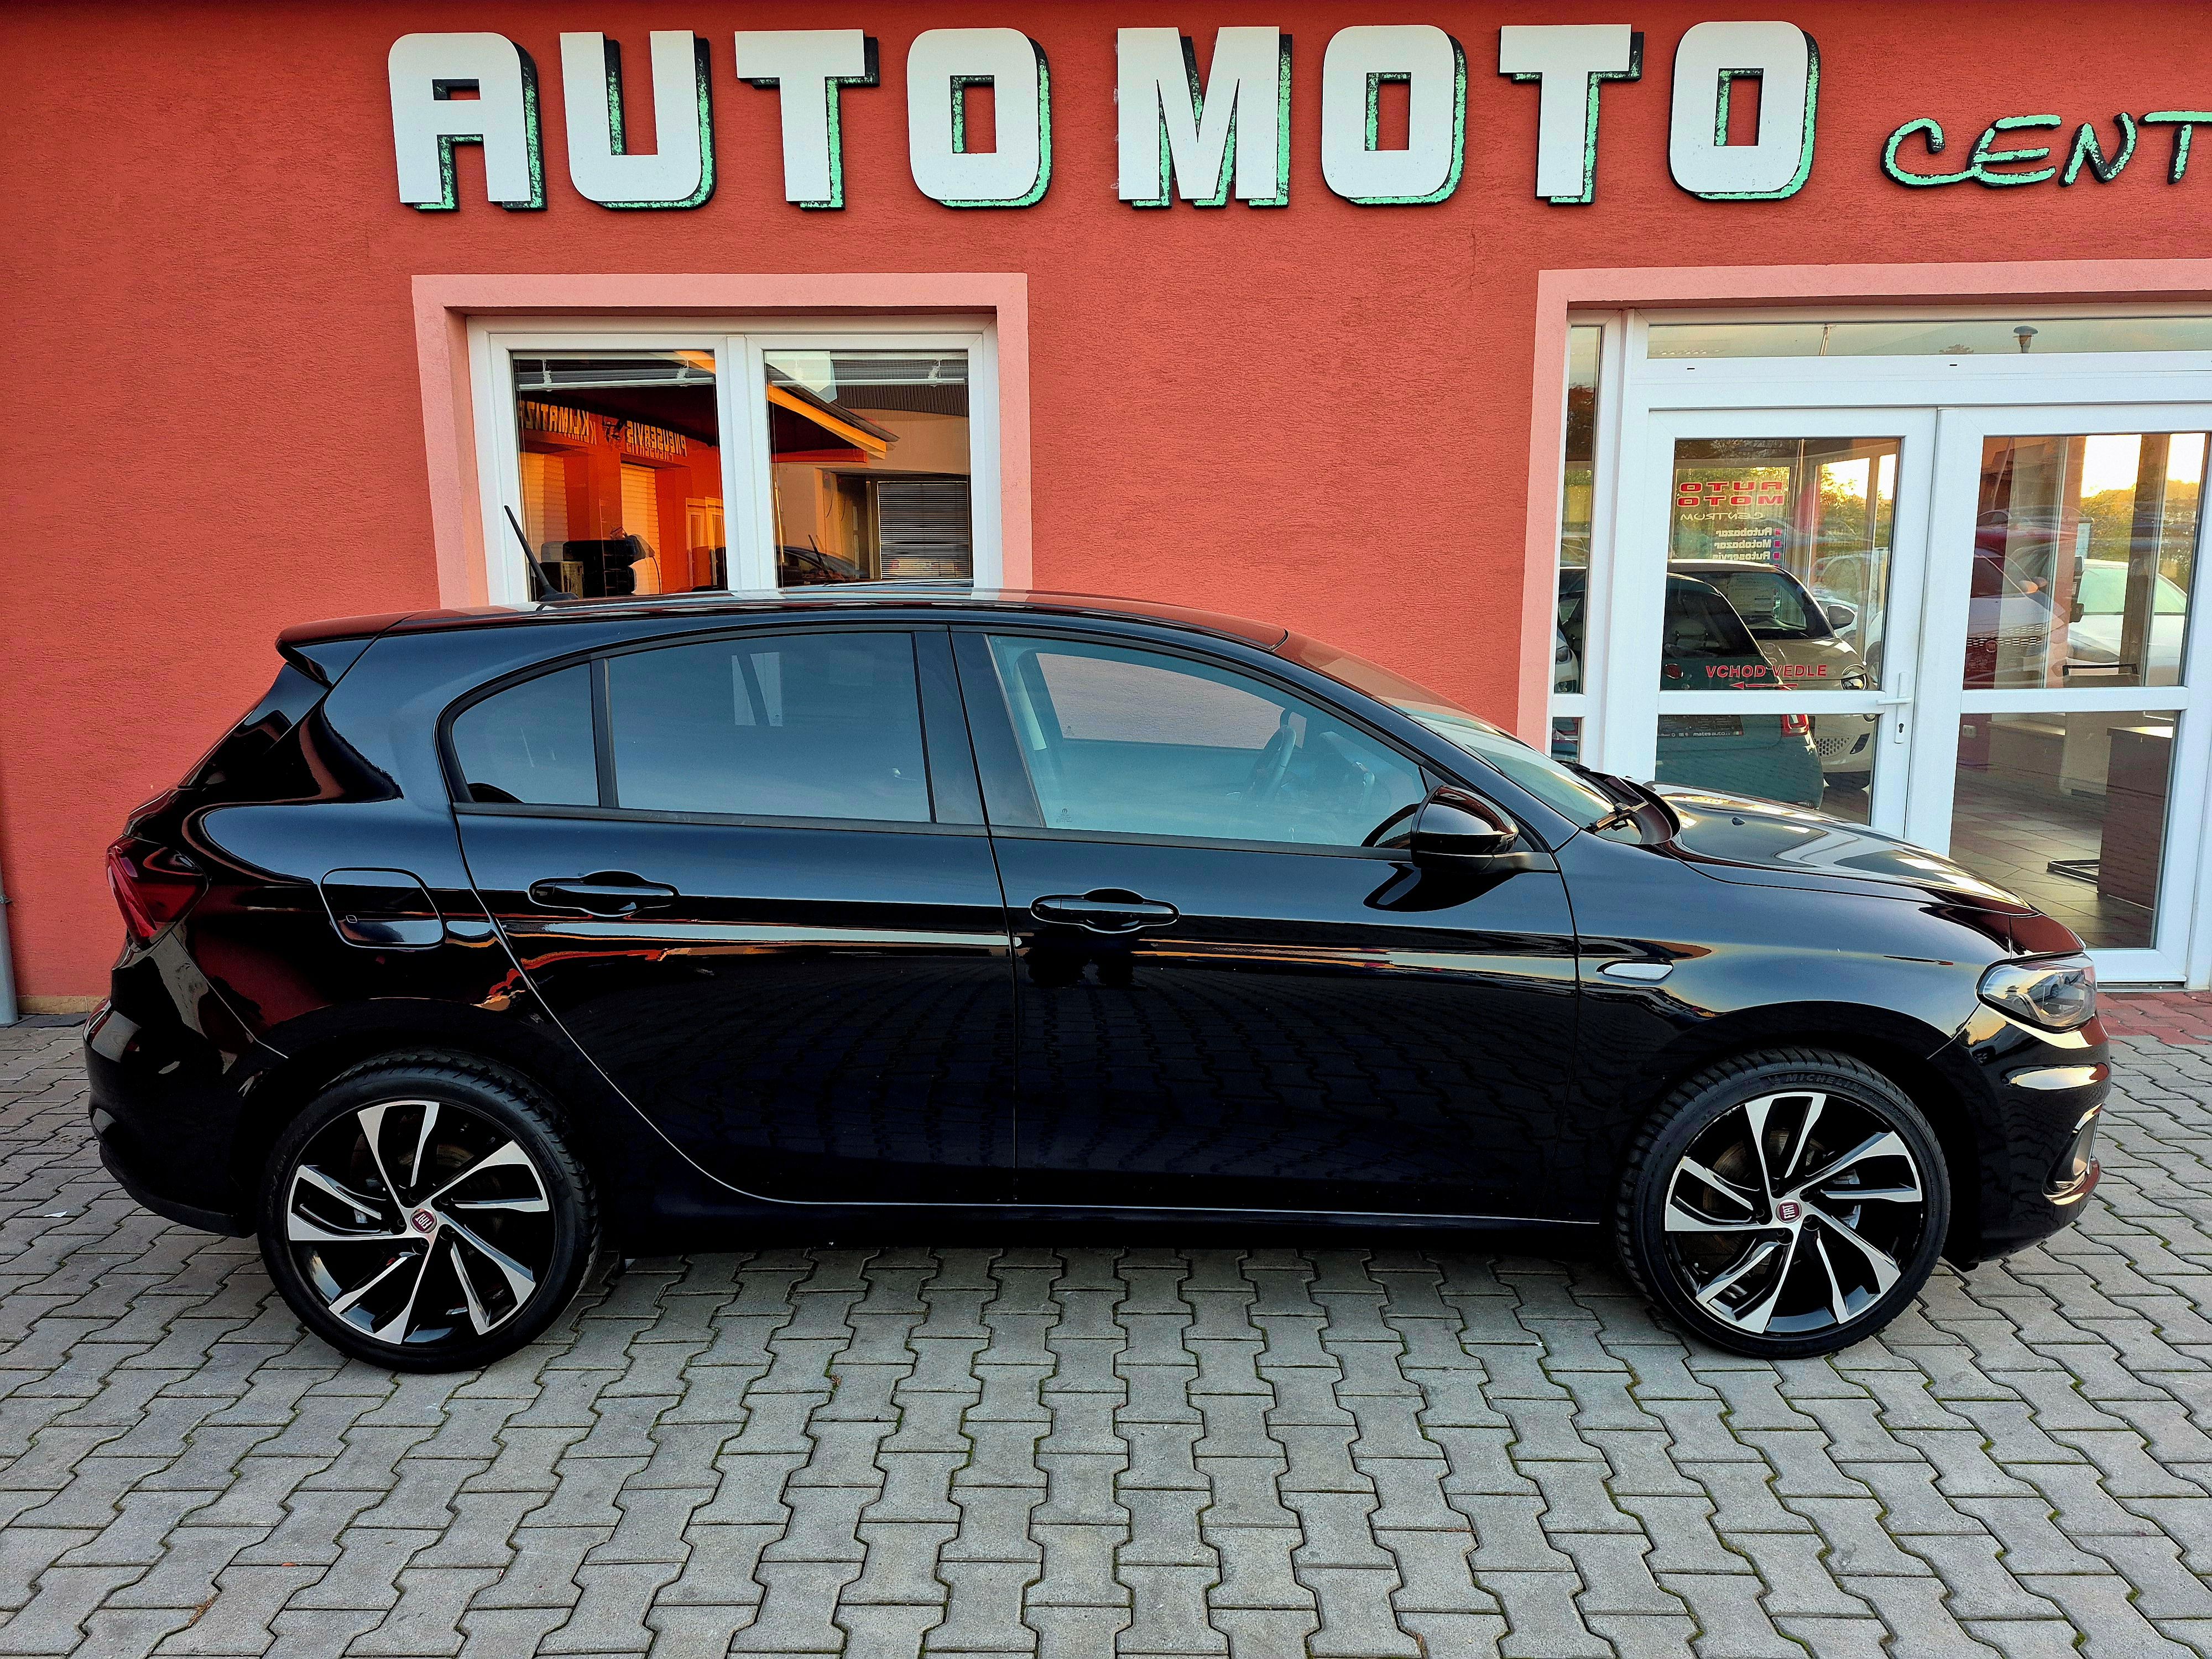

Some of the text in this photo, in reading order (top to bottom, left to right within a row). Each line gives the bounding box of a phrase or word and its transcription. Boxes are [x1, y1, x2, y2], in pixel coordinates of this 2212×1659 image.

[388, 20, 1820, 211] AUTO MOTO
[1880, 110, 2212, 189] CENT
[1705, 665, 1827, 678] VCHOD VEDLE
[1786, 1074, 1863, 1092] MICHELIN
[1782, 1204, 1796, 1219] FIAT
[415, 1213, 432, 1229] FIAT
